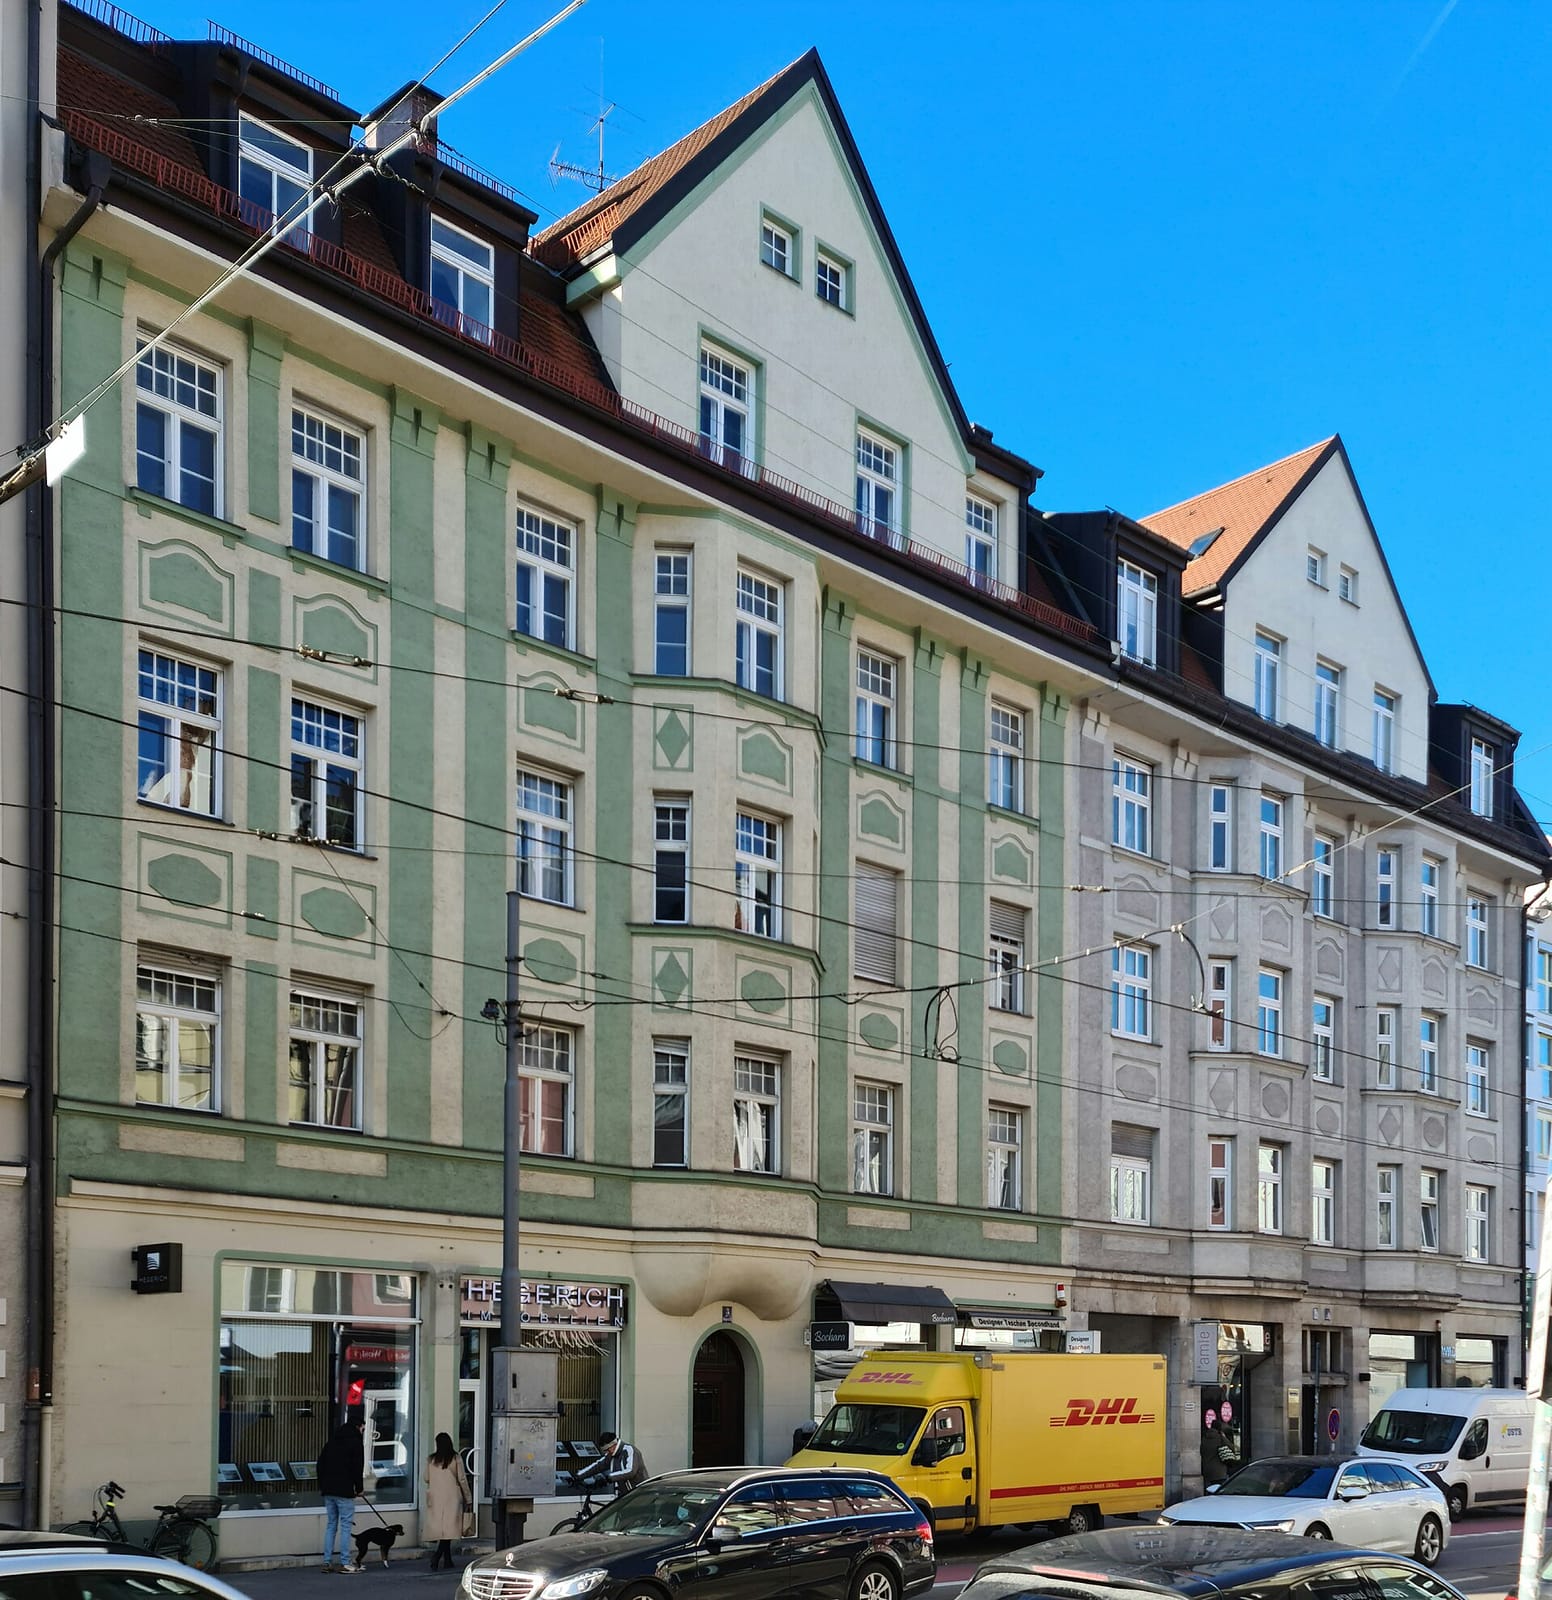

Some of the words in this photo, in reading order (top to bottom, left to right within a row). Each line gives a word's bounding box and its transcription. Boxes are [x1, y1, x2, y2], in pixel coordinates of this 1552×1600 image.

[467, 1279, 624, 1308] HEGERICH
[467, 1310, 624, 1327] IMOBILIEN
[931, 1312, 955, 1323] Bochara
[978, 1318, 1003, 1327] Designer
[1004, 1319, 1026, 1327] Taschen
[814, 1328, 846, 1342] Bochara
[859, 1372, 914, 1384] DHL
[1065, 1398, 1141, 1426] DHL
